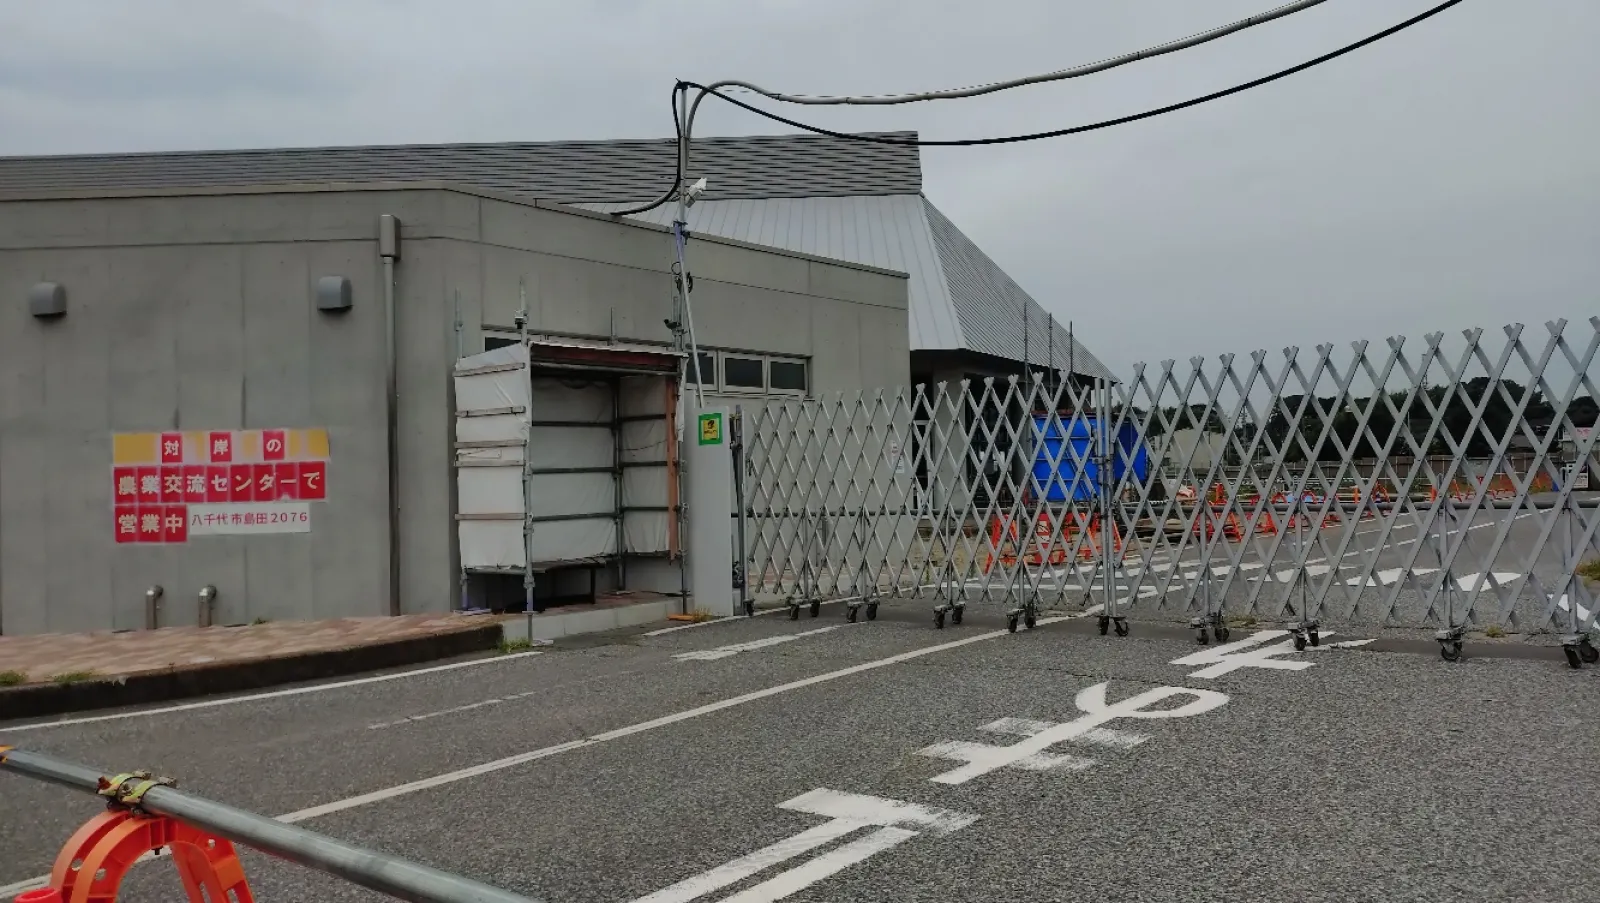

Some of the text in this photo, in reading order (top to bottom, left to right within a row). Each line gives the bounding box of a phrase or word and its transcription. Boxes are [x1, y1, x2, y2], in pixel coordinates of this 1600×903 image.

[164, 439, 282, 456] 対岸の
[119, 472, 320, 495] 農業交流センターで
[119, 514, 183, 533] 営業中
[191, 512, 308, 526] 八千代市島田2076
